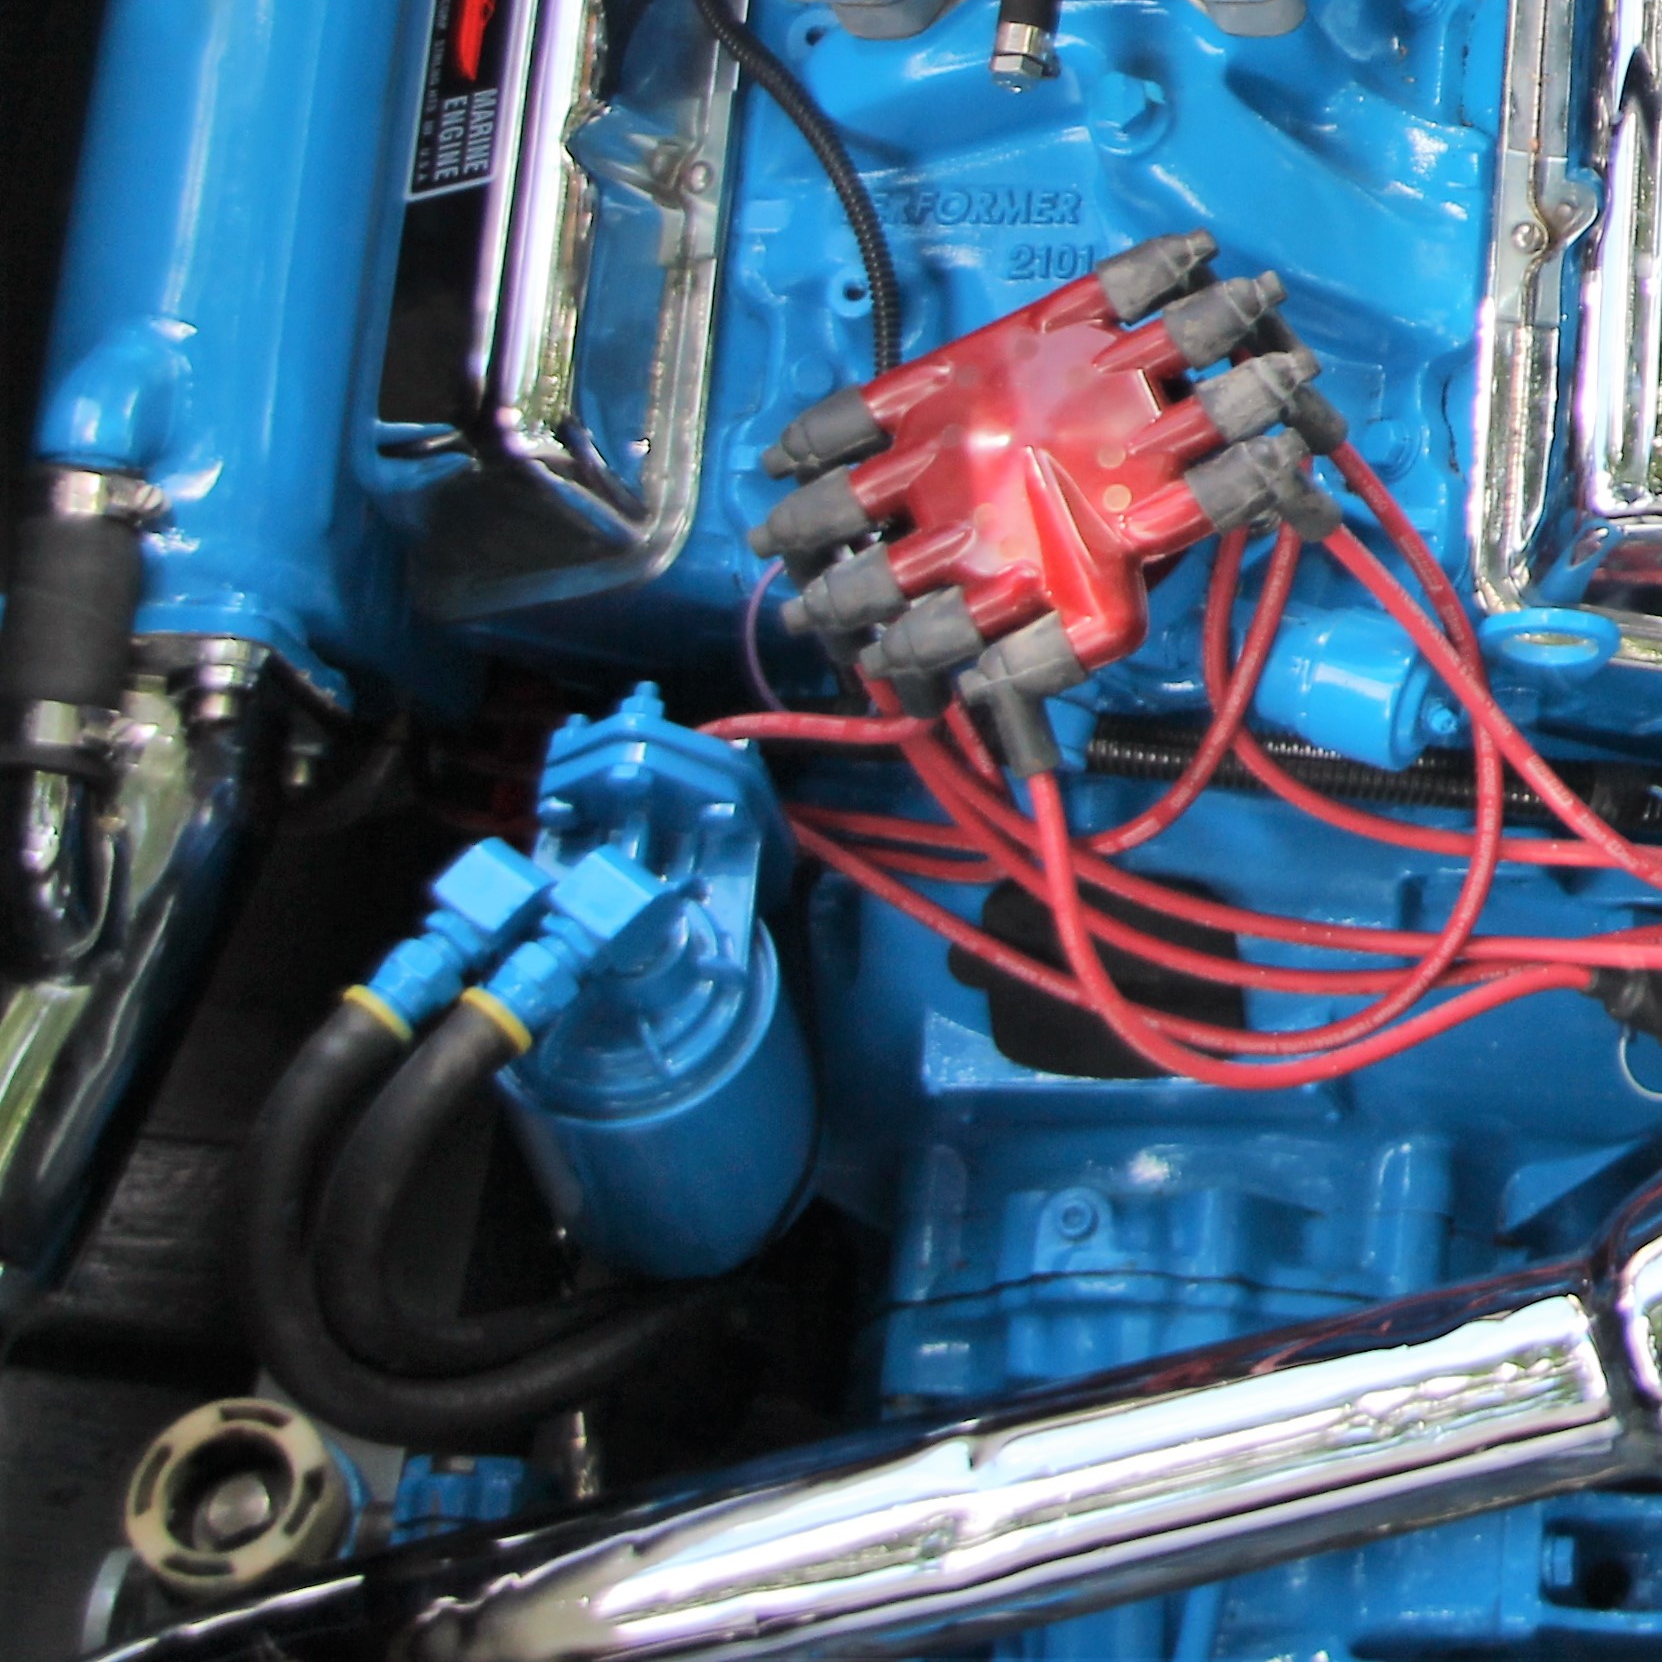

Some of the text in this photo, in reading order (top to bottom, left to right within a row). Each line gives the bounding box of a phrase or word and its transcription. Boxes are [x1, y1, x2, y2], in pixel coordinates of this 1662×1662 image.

[433, 93, 469, 183] ENGINE
[463, 86, 499, 175] MARINE
[868, 188, 1084, 226] ERFORMER
[1006, 242, 1096, 280] 2101
